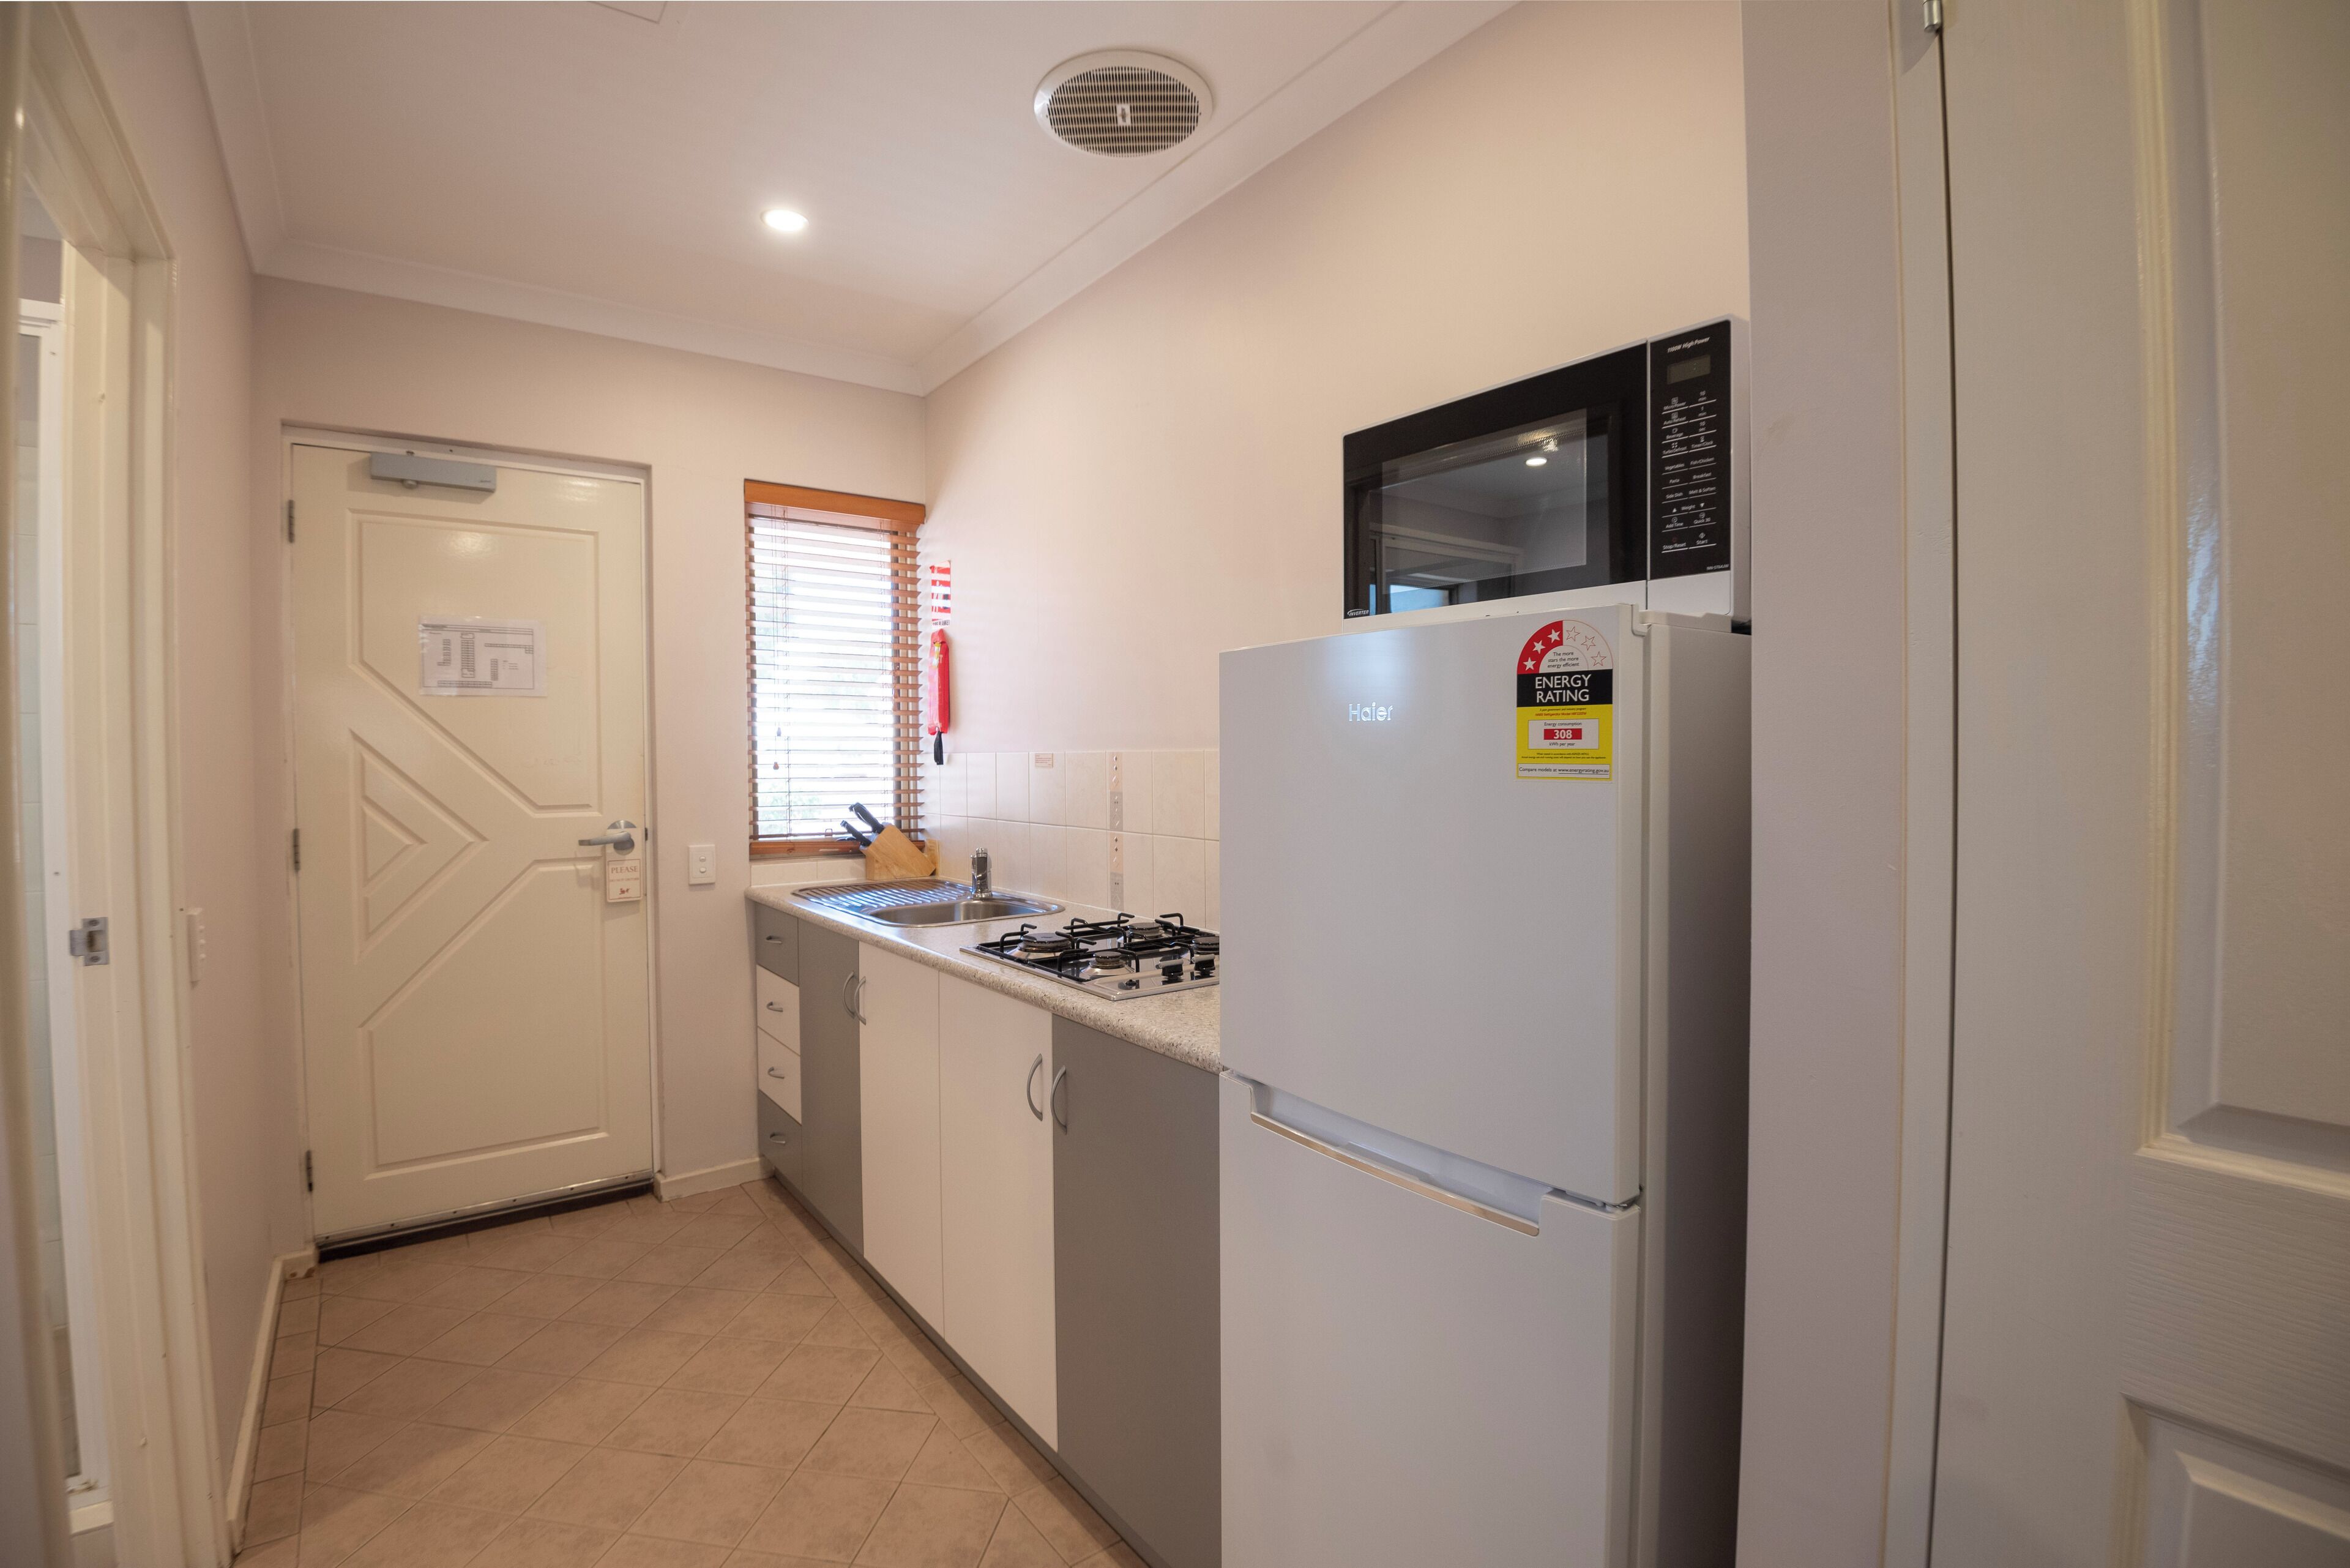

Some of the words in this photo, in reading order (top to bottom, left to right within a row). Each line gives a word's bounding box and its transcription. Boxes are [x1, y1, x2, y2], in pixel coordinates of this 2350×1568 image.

[1667, 344, 1682, 353] 1100W
[1682, 340, 1695, 349] High
[1694, 337, 1710, 345] Power
[1535, 674, 1591, 689] ENERGY
[1536, 689, 1590, 703] RATING
[1348, 701, 1393, 721] Haier
[1553, 729, 1573, 739] 308
